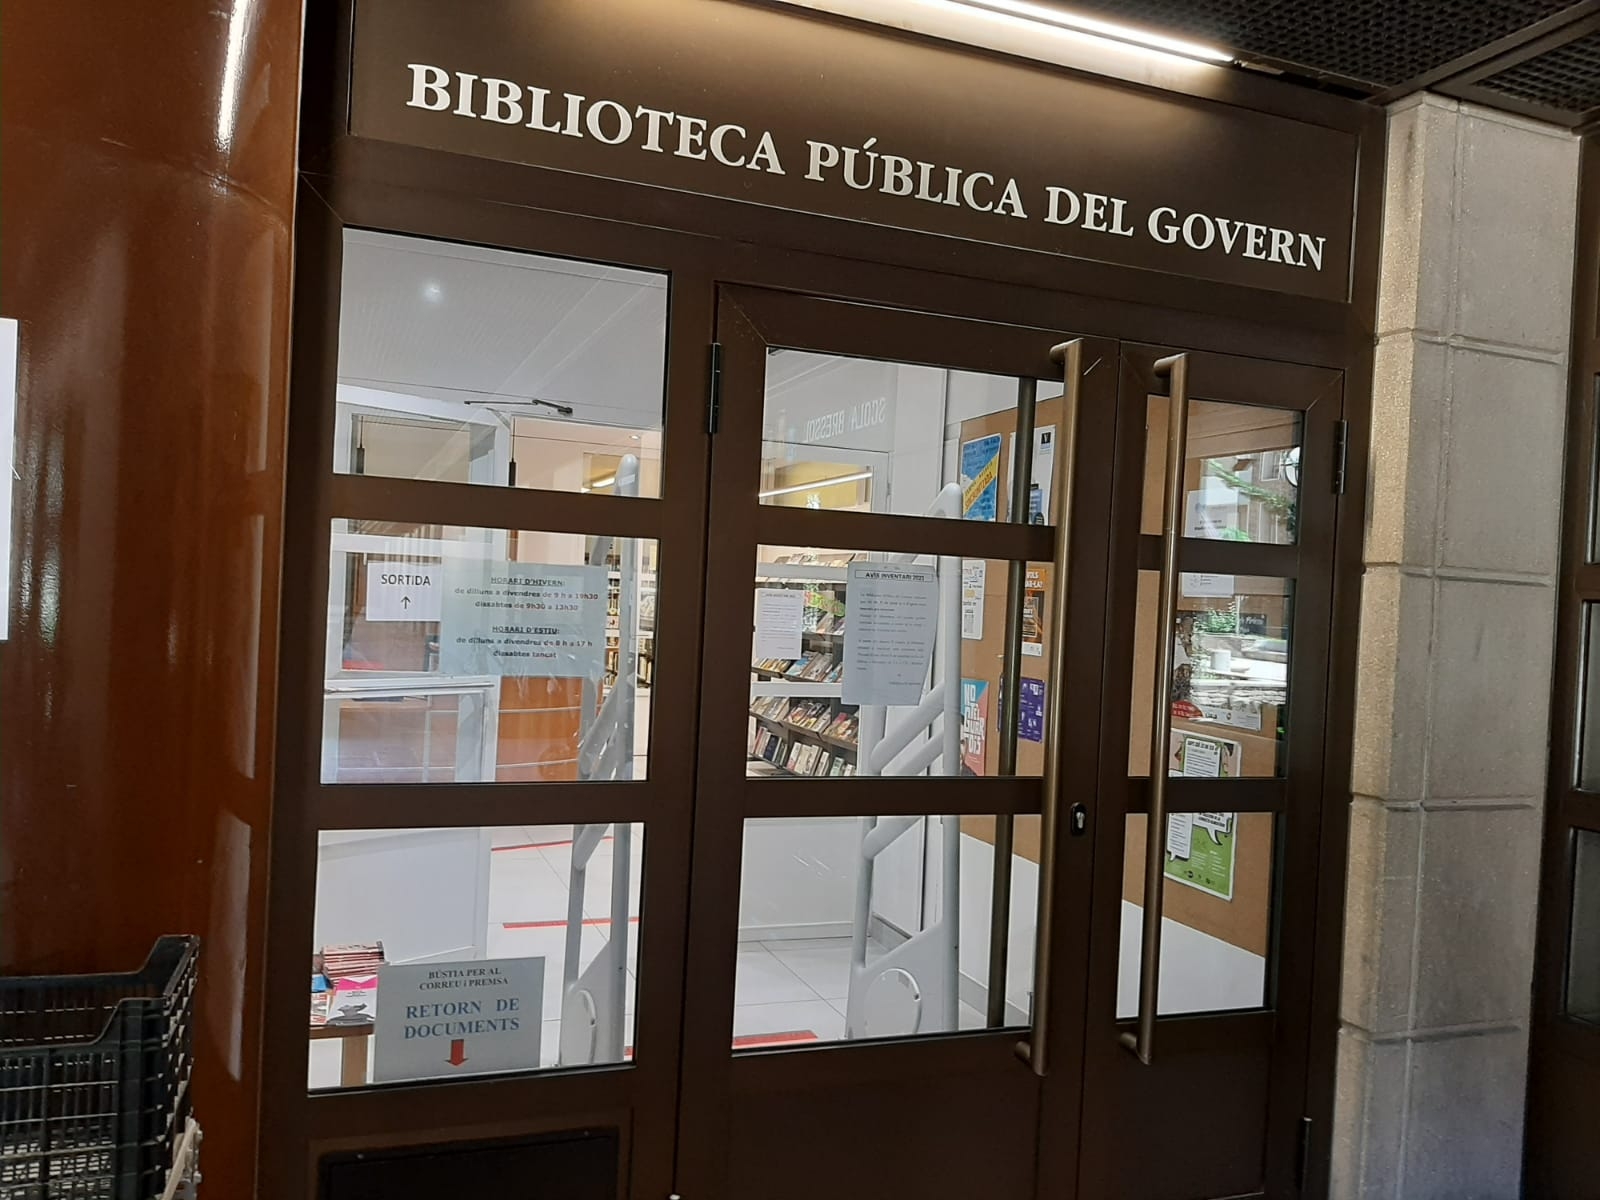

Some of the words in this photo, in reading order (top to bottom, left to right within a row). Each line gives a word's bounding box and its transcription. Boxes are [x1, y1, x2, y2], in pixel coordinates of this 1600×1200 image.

[407, 63, 786, 175] BIBLIOTECA
[804, 137, 1028, 218] PÚBLICA
[1044, 186, 1134, 237] DEL
[1147, 206, 1327, 271] GOVERN
[380, 573, 431, 586] SORTIDA
[502, 588, 541, 598] divendres
[474, 600, 513, 610] dissabtes
[492, 625, 524, 634] HORARI
[503, 638, 542, 647] divendres
[466, 968, 486, 977] PER
[488, 967, 502, 975] AL
[419, 980, 462, 991] CORREU
[468, 977, 509, 987] PREMSA
[406, 1000, 482, 1019] RETORN
[496, 998, 520, 1012] DE
[404, 1018, 520, 1039] DOCUMENTS
